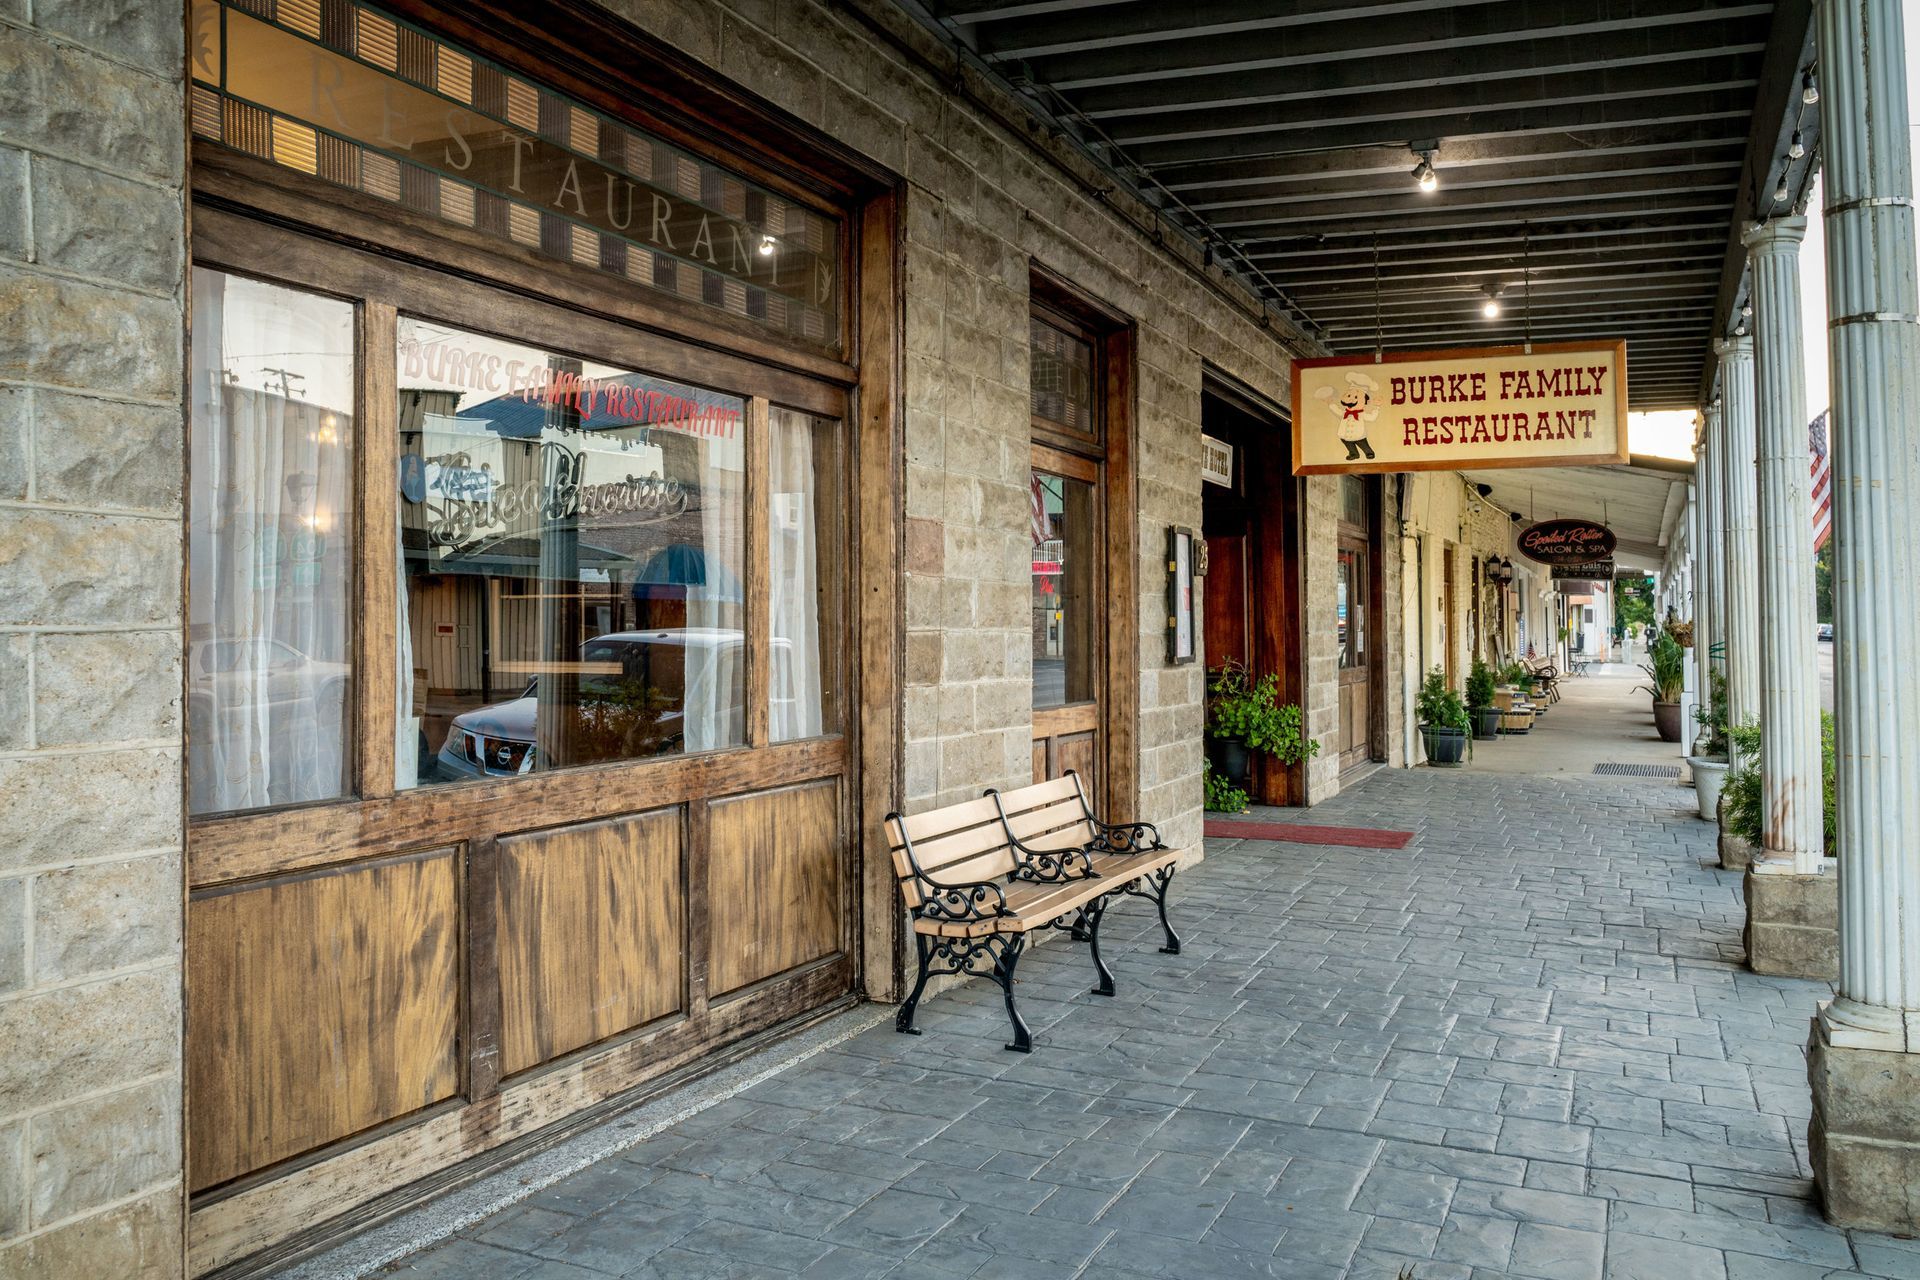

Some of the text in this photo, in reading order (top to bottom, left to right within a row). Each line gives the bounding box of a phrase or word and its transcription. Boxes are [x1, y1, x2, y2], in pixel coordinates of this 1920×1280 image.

[306, 50, 785, 288] RESTAURANT
[401, 338, 741, 439] BURKE FAMILY RESTAURANT
[1391, 366, 1607, 405] BURKE FAMILY
[1403, 409, 1596, 446] RESTAURANT
[1525, 530, 1568, 549] Spoiled
[1537, 544, 1607, 554] SALON & SPA
